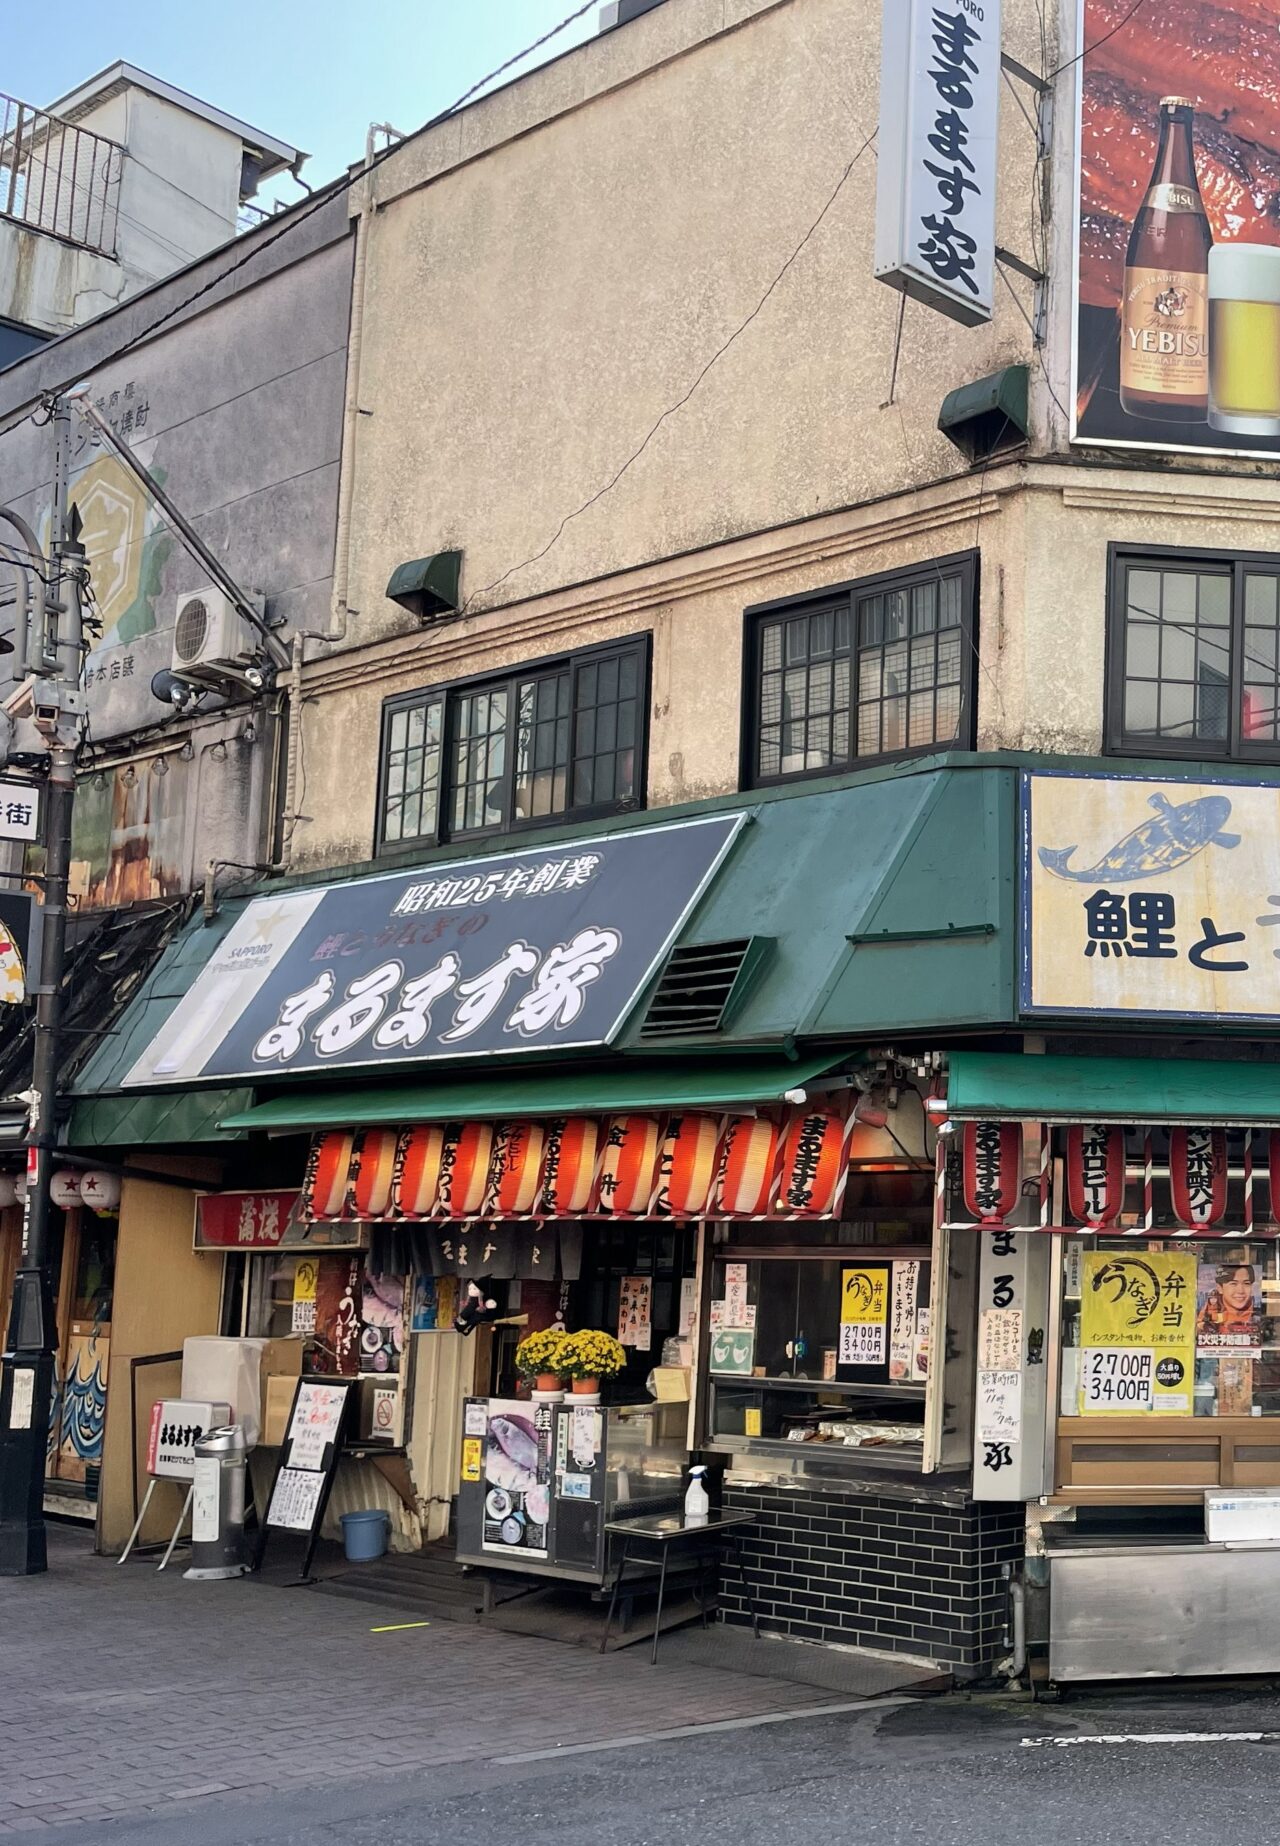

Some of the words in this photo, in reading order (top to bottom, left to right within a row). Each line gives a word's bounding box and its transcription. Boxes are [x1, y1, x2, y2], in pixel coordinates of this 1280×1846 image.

[917, 7, 982, 295] まるます家
[392, 852, 601, 916] 昭和25年創業
[252, 926, 624, 1064] まるます家
[600, 1125, 630, 1196] 金升
[786, 1117, 830, 1207] まるます家
[975, 1122, 1003, 1209] まるます家
[1082, 1124, 1111, 1215] ッポロビール
[237, 1198, 281, 1243] 蒲焼
[873, 1280, 884, 1313] 弁当
[904, 1261, 917, 1338] お持ち帰り
[1161, 1270, 1187, 1328] 弁当
[844, 1325, 882, 1338] 2700円
[844, 1339, 882, 1351] 3400円
[982, 1374, 1018, 1386] 営業時間
[1160, 1363, 1180, 1371] 大盛り
